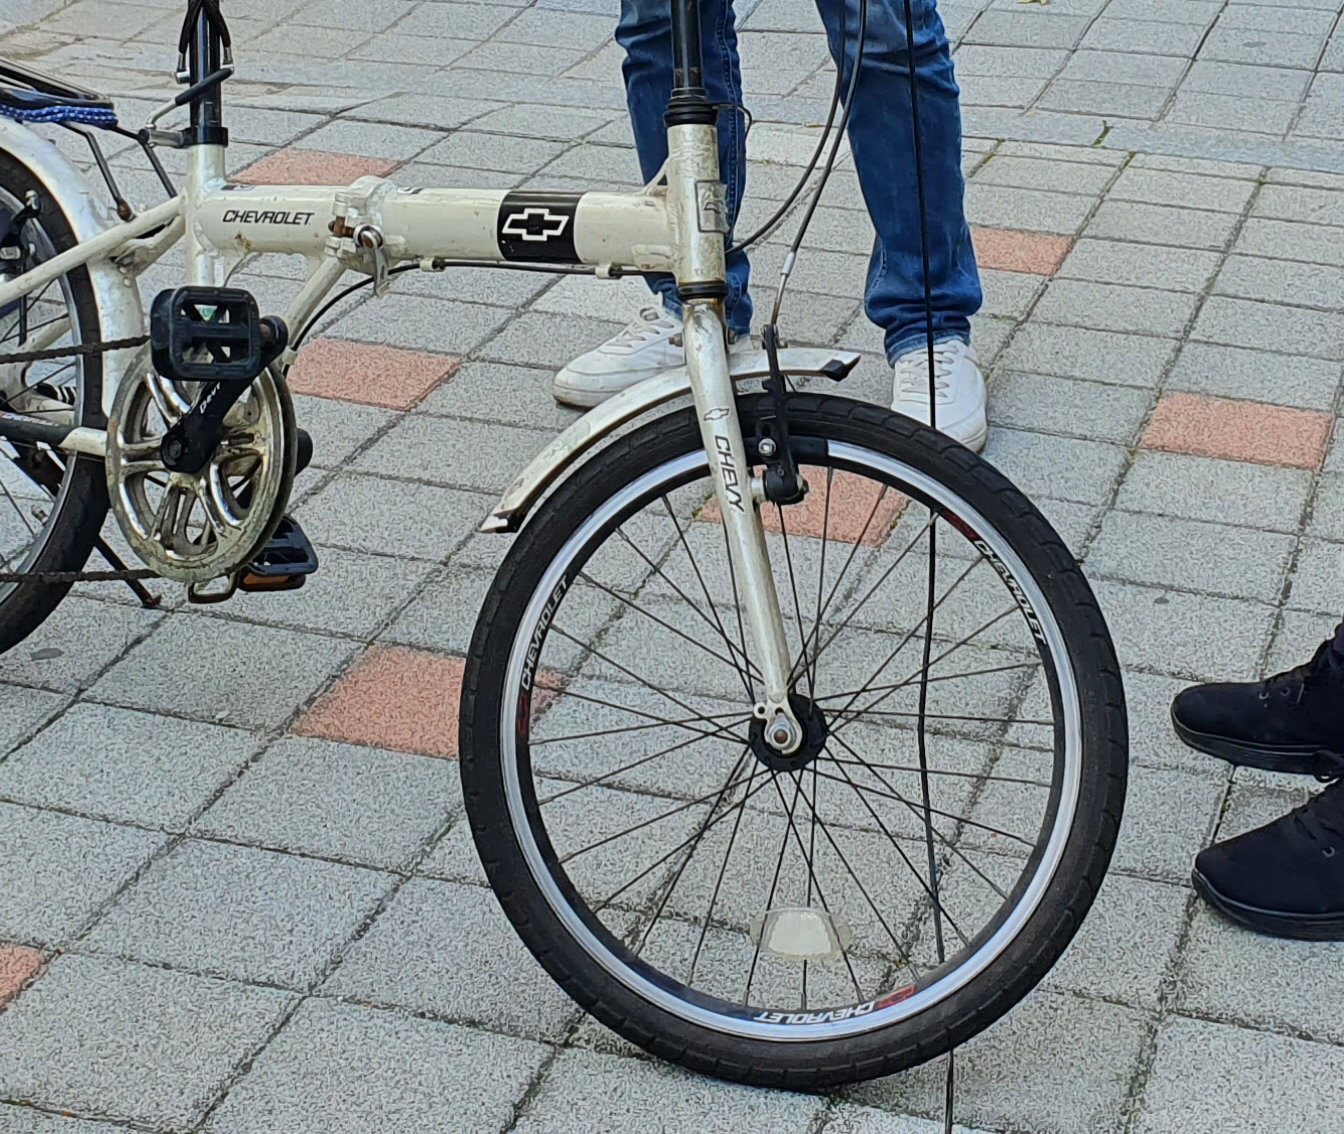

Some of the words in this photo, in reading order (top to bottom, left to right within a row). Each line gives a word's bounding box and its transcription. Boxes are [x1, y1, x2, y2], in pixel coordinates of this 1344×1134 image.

[223, 210, 315, 225] CHEVROLET
[715, 435, 745, 513] CHEVY
[973, 540, 1047, 645] CHEVROLET
[521, 574, 569, 691] CHEVROLET
[753, 1000, 876, 1025] CHEVROLET
